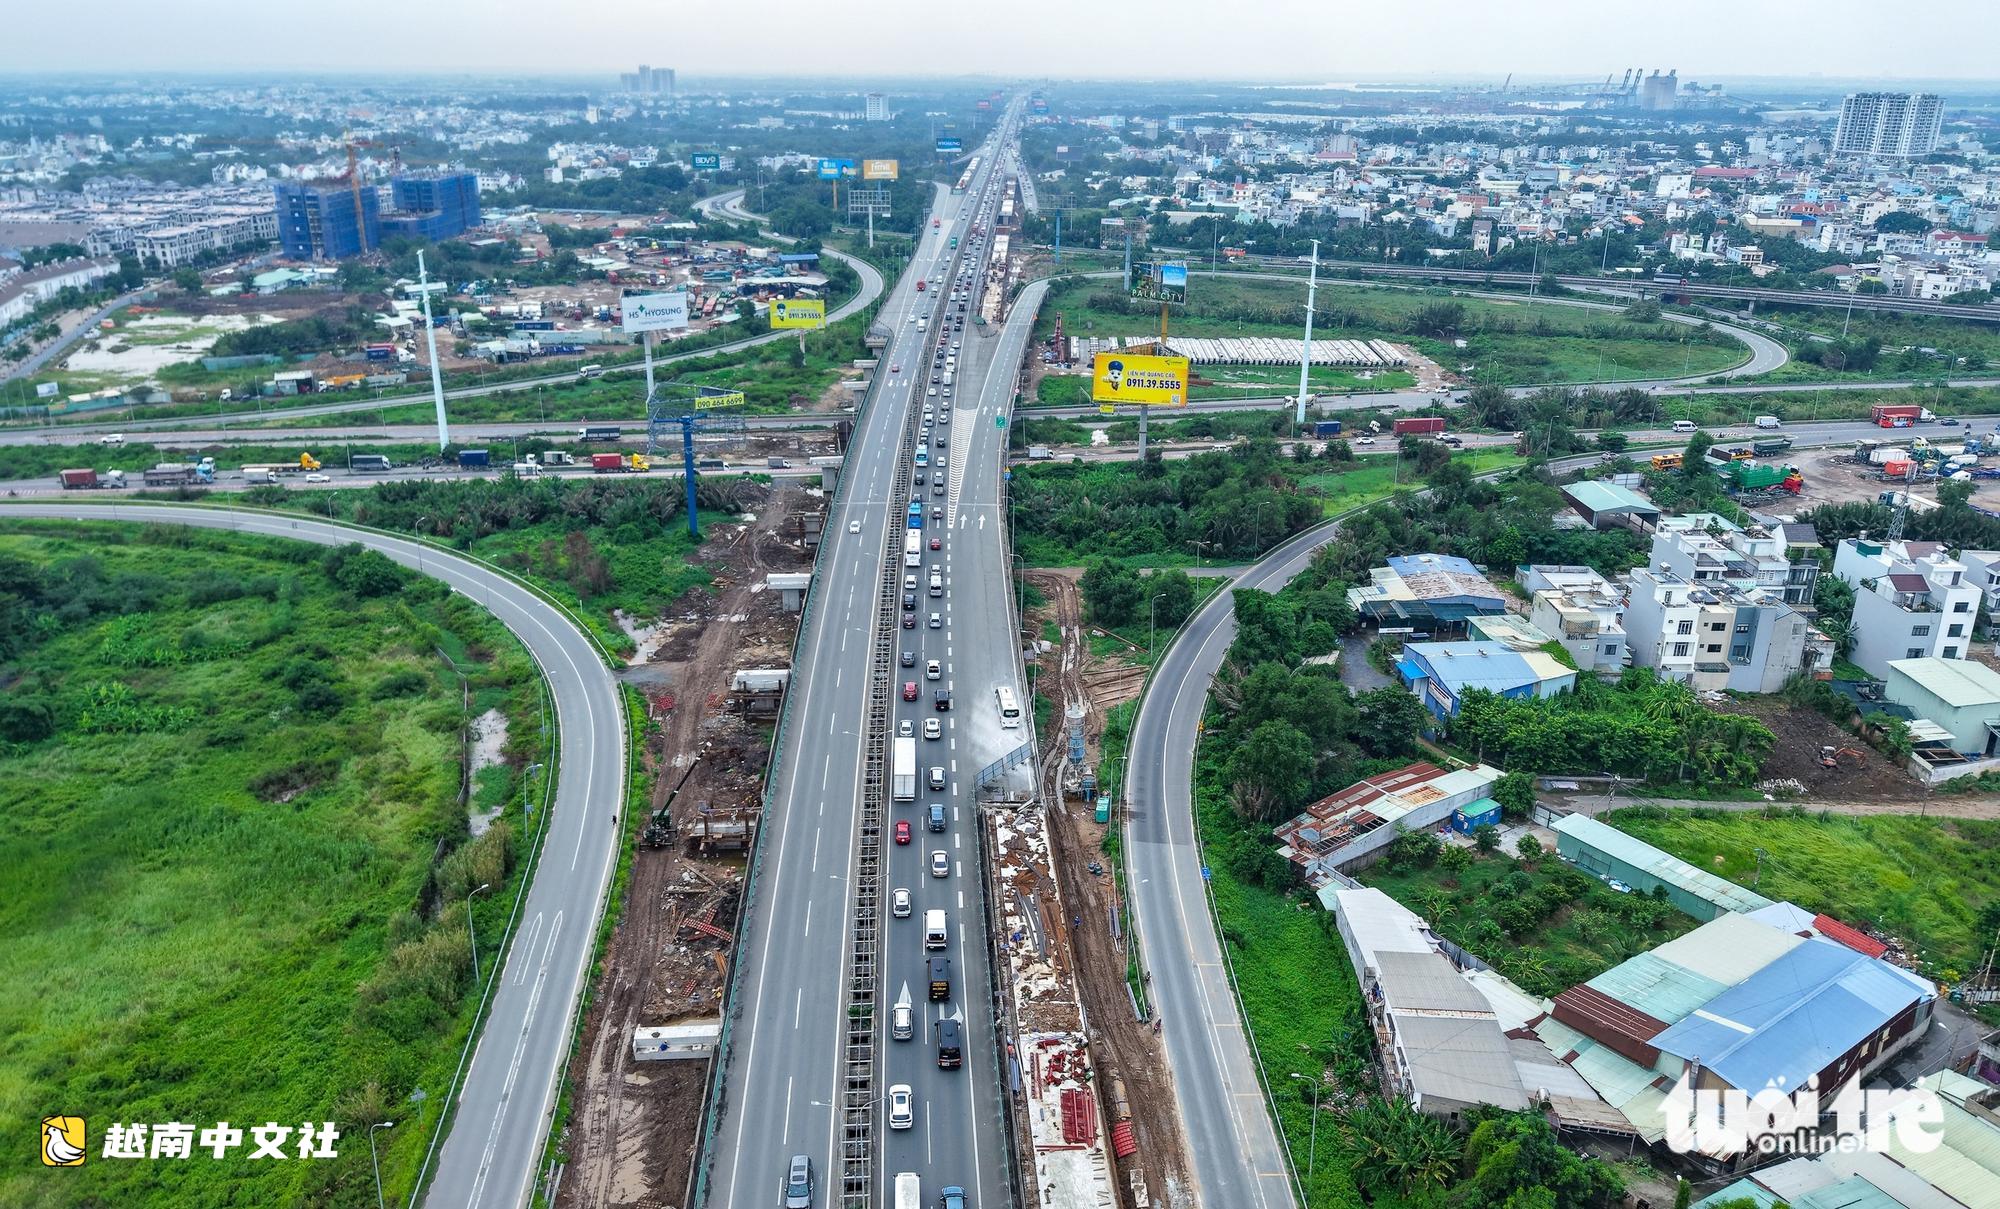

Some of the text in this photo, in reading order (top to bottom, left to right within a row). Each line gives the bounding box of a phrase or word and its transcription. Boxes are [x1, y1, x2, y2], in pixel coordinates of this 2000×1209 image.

[1132, 289, 1183, 301] PALM CITY
[629, 307, 682, 319] HS HYOSUNG
[1127, 378, 1181, 389] 0911.39.5555
[697, 400, 710, 408] 090
